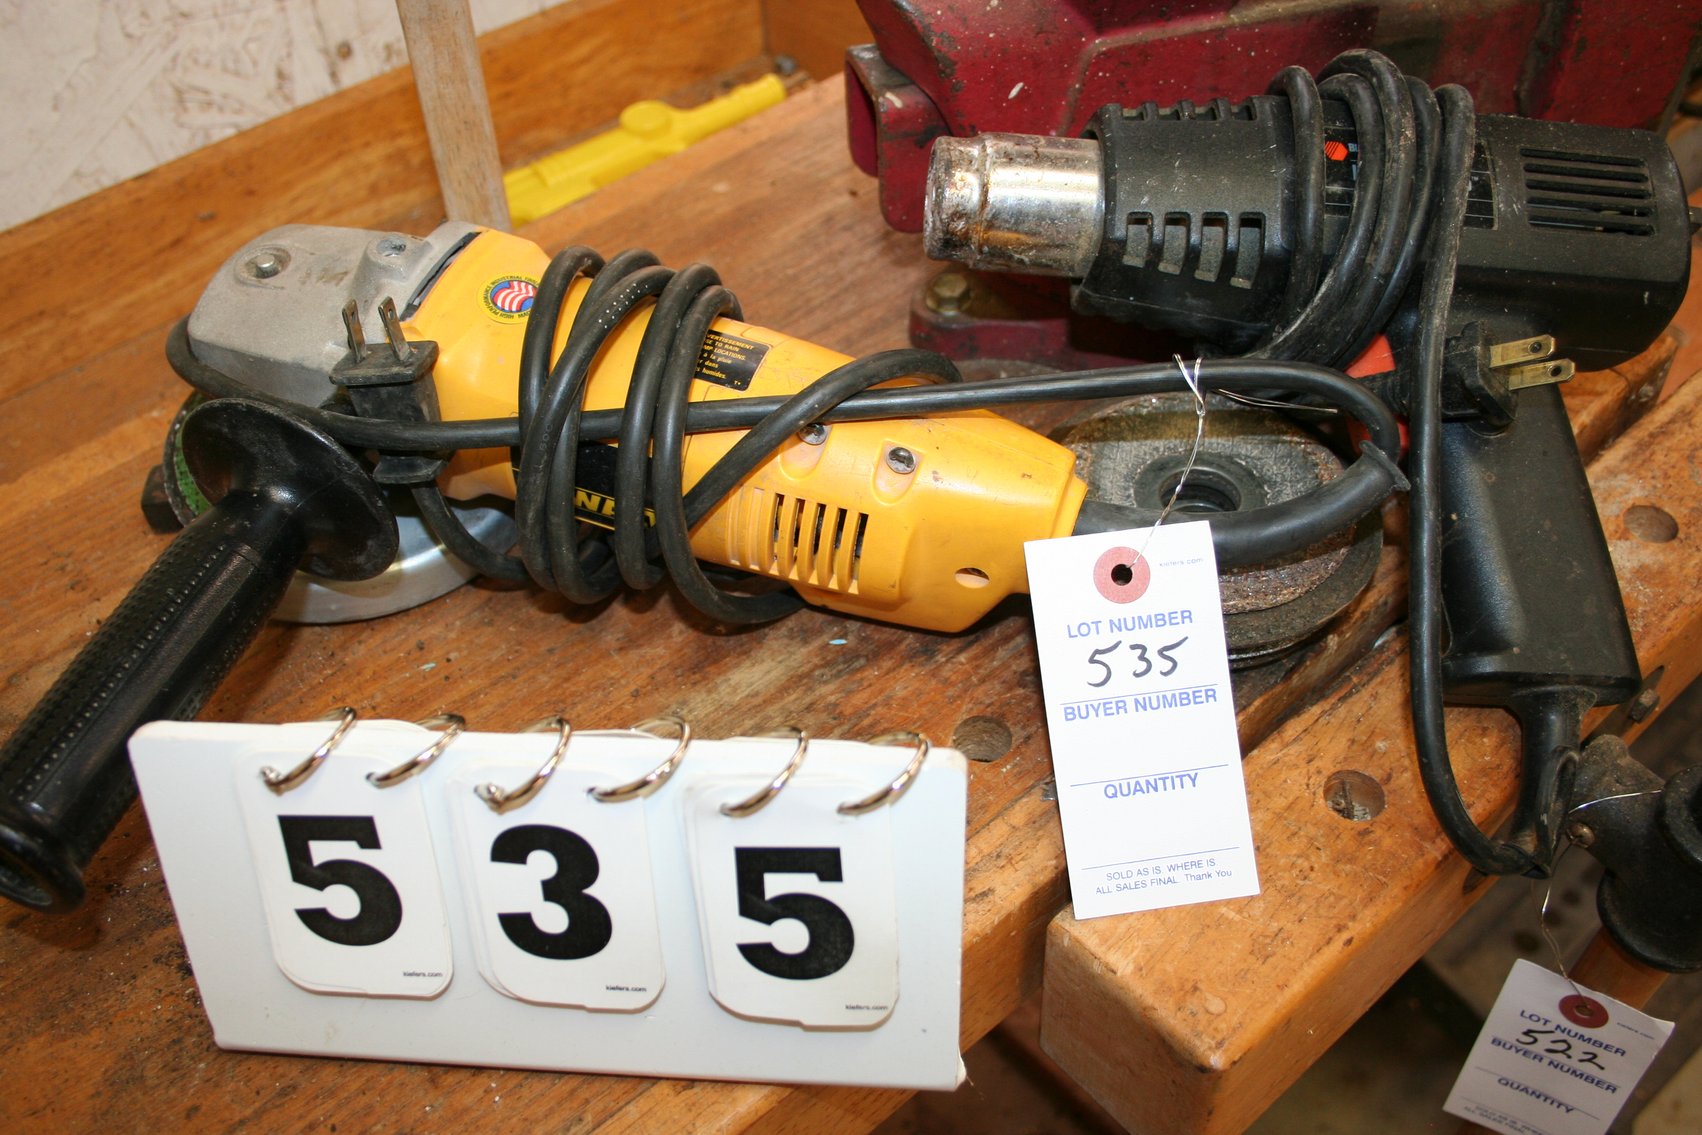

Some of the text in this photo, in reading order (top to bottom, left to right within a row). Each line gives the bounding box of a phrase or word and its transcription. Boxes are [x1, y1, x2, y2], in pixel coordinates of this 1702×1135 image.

[1067, 609, 1193, 638] LOT NUMBER
[1086, 636, 1189, 687] 535
[1063, 688, 1218, 721] BUYER NUMBER
[1103, 772, 1199, 799] QUANTITY
[1095, 885, 1113, 895] ALL
[1115, 880, 1147, 892] SALES
[1184, 871, 1213, 882] Thank
[1215, 869, 1233, 878] You
[1106, 869, 1133, 882] SOLD
[1136, 867, 1149, 877] AS
[1166, 860, 1204, 873] WHERE
[1516, 1029, 1605, 1071] 522
[1520, 1009, 1551, 1026] LOT
[1554, 1024, 1626, 1057] NUMBER
[1491, 1038, 1618, 1094] BUYER NUMBER
[1497, 1077, 1576, 1114] QUANTITY
